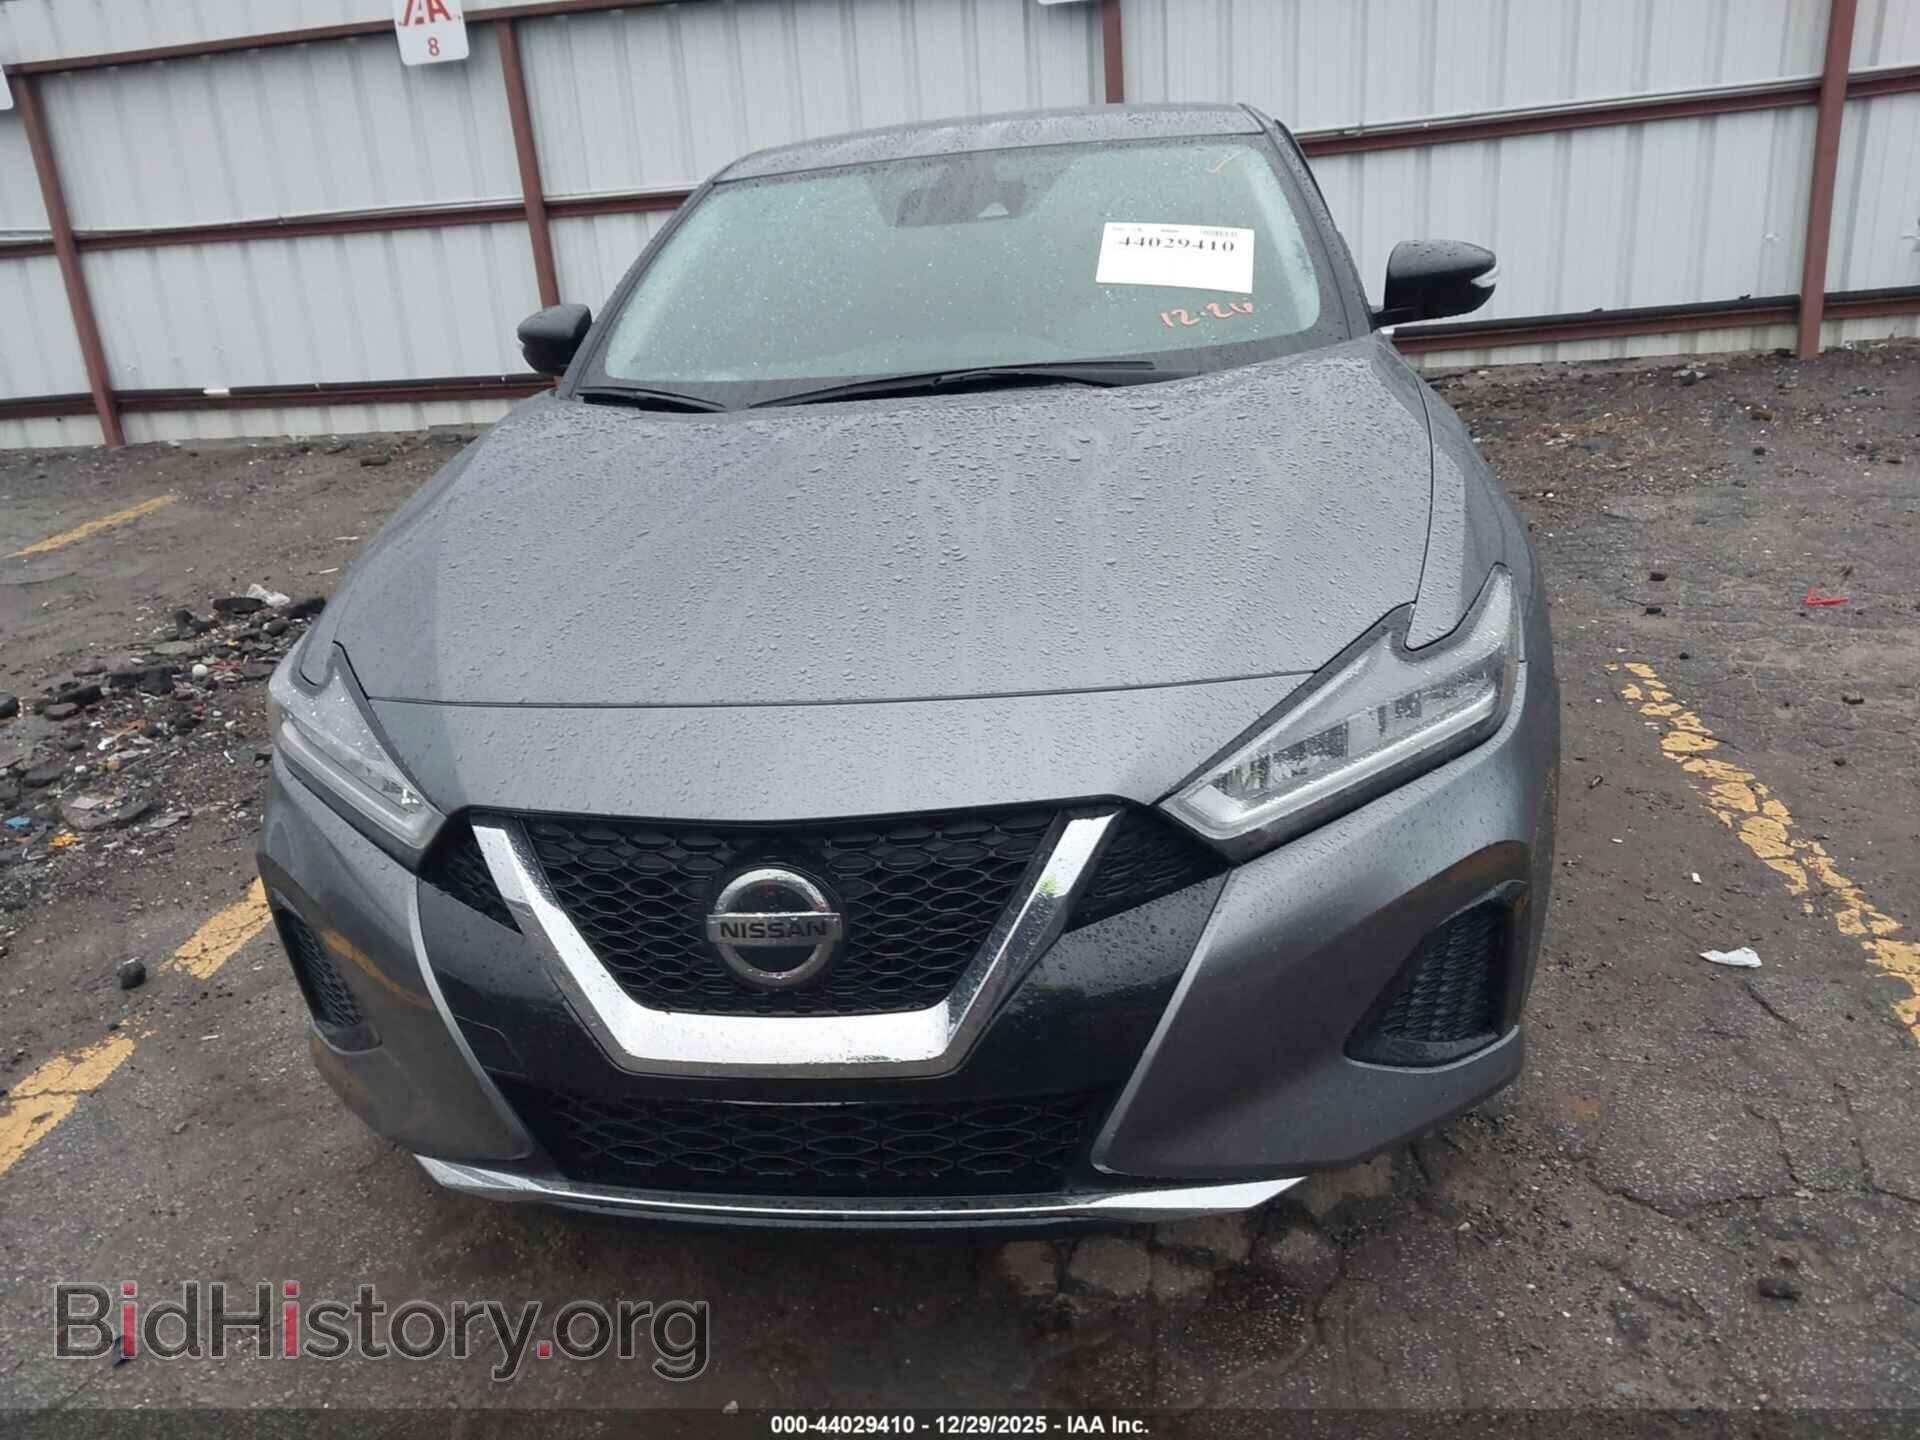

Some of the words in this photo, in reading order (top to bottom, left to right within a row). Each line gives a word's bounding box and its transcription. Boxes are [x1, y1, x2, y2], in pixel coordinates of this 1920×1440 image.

[428, 37, 440, 56] 8
[1117, 236, 1235, 252] 44029410
[720, 921, 827, 939] NISSAN
